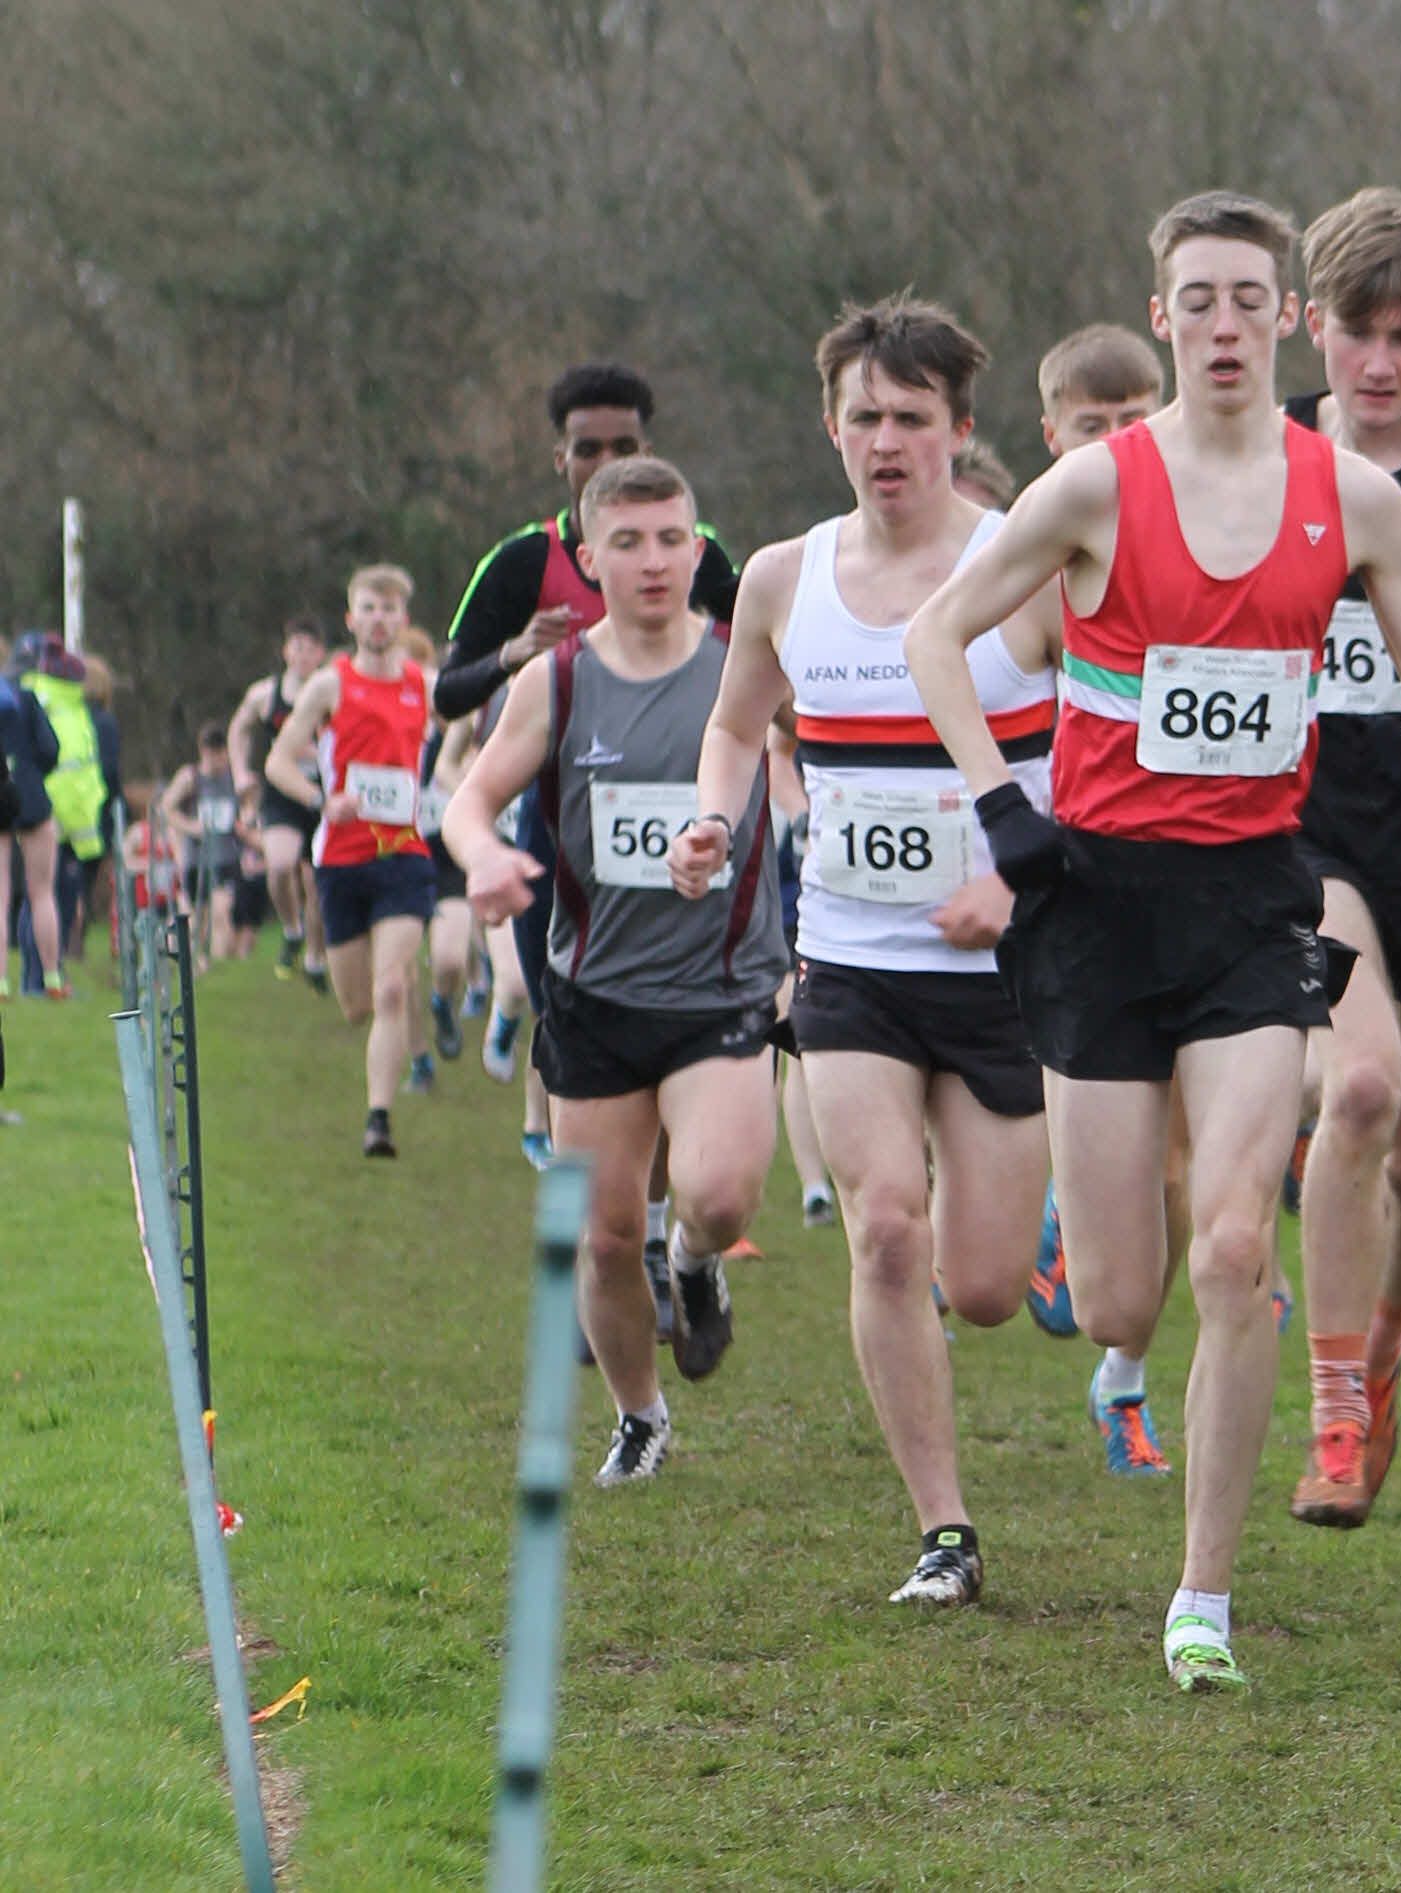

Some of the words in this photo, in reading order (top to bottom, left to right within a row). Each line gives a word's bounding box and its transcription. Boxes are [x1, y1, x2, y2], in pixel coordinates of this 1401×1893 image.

[804, 665, 848, 681] AFAN
[1160, 687, 1271, 743] 864
[611, 817, 697, 858] 56
[840, 822, 933, 871] 168
